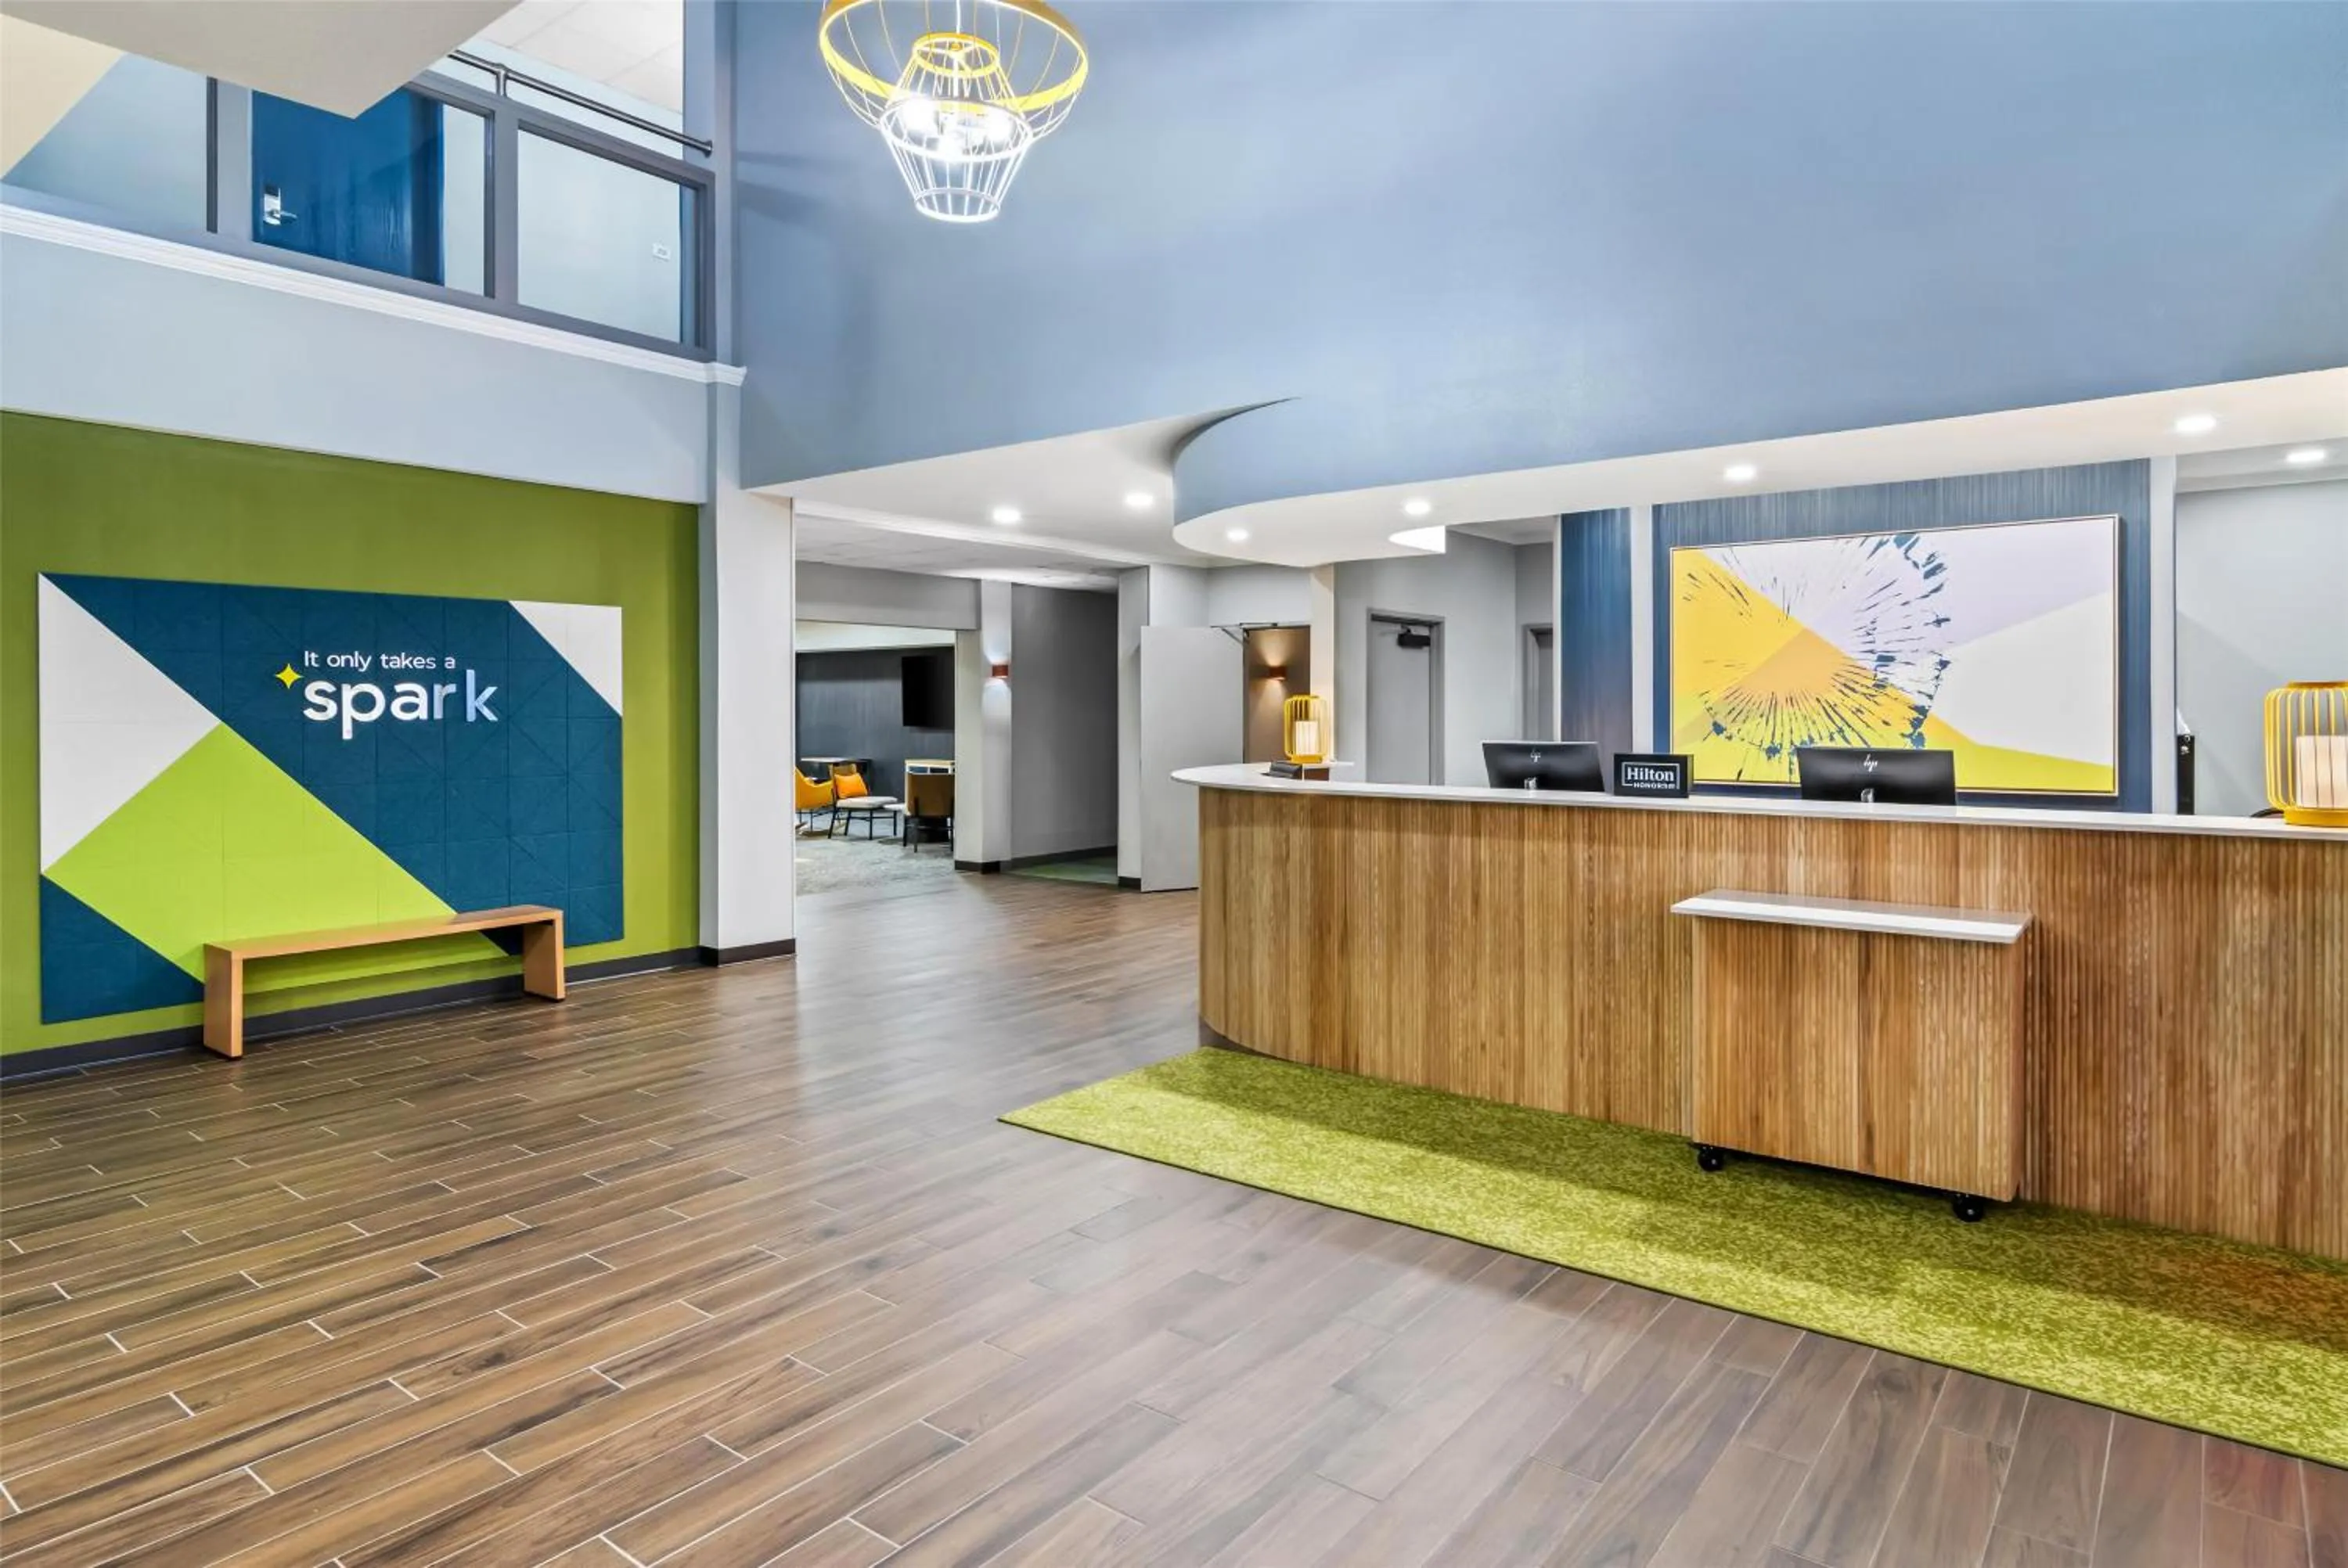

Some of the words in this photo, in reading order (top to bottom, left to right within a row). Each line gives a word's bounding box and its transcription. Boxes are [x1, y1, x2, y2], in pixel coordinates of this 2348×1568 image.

[304, 650, 319, 668] It
[326, 651, 373, 672] only
[380, 652, 437, 670] takes
[444, 656, 456, 669] a
[303, 669, 499, 741] spark
[1627, 766, 1675, 782] Hilton
